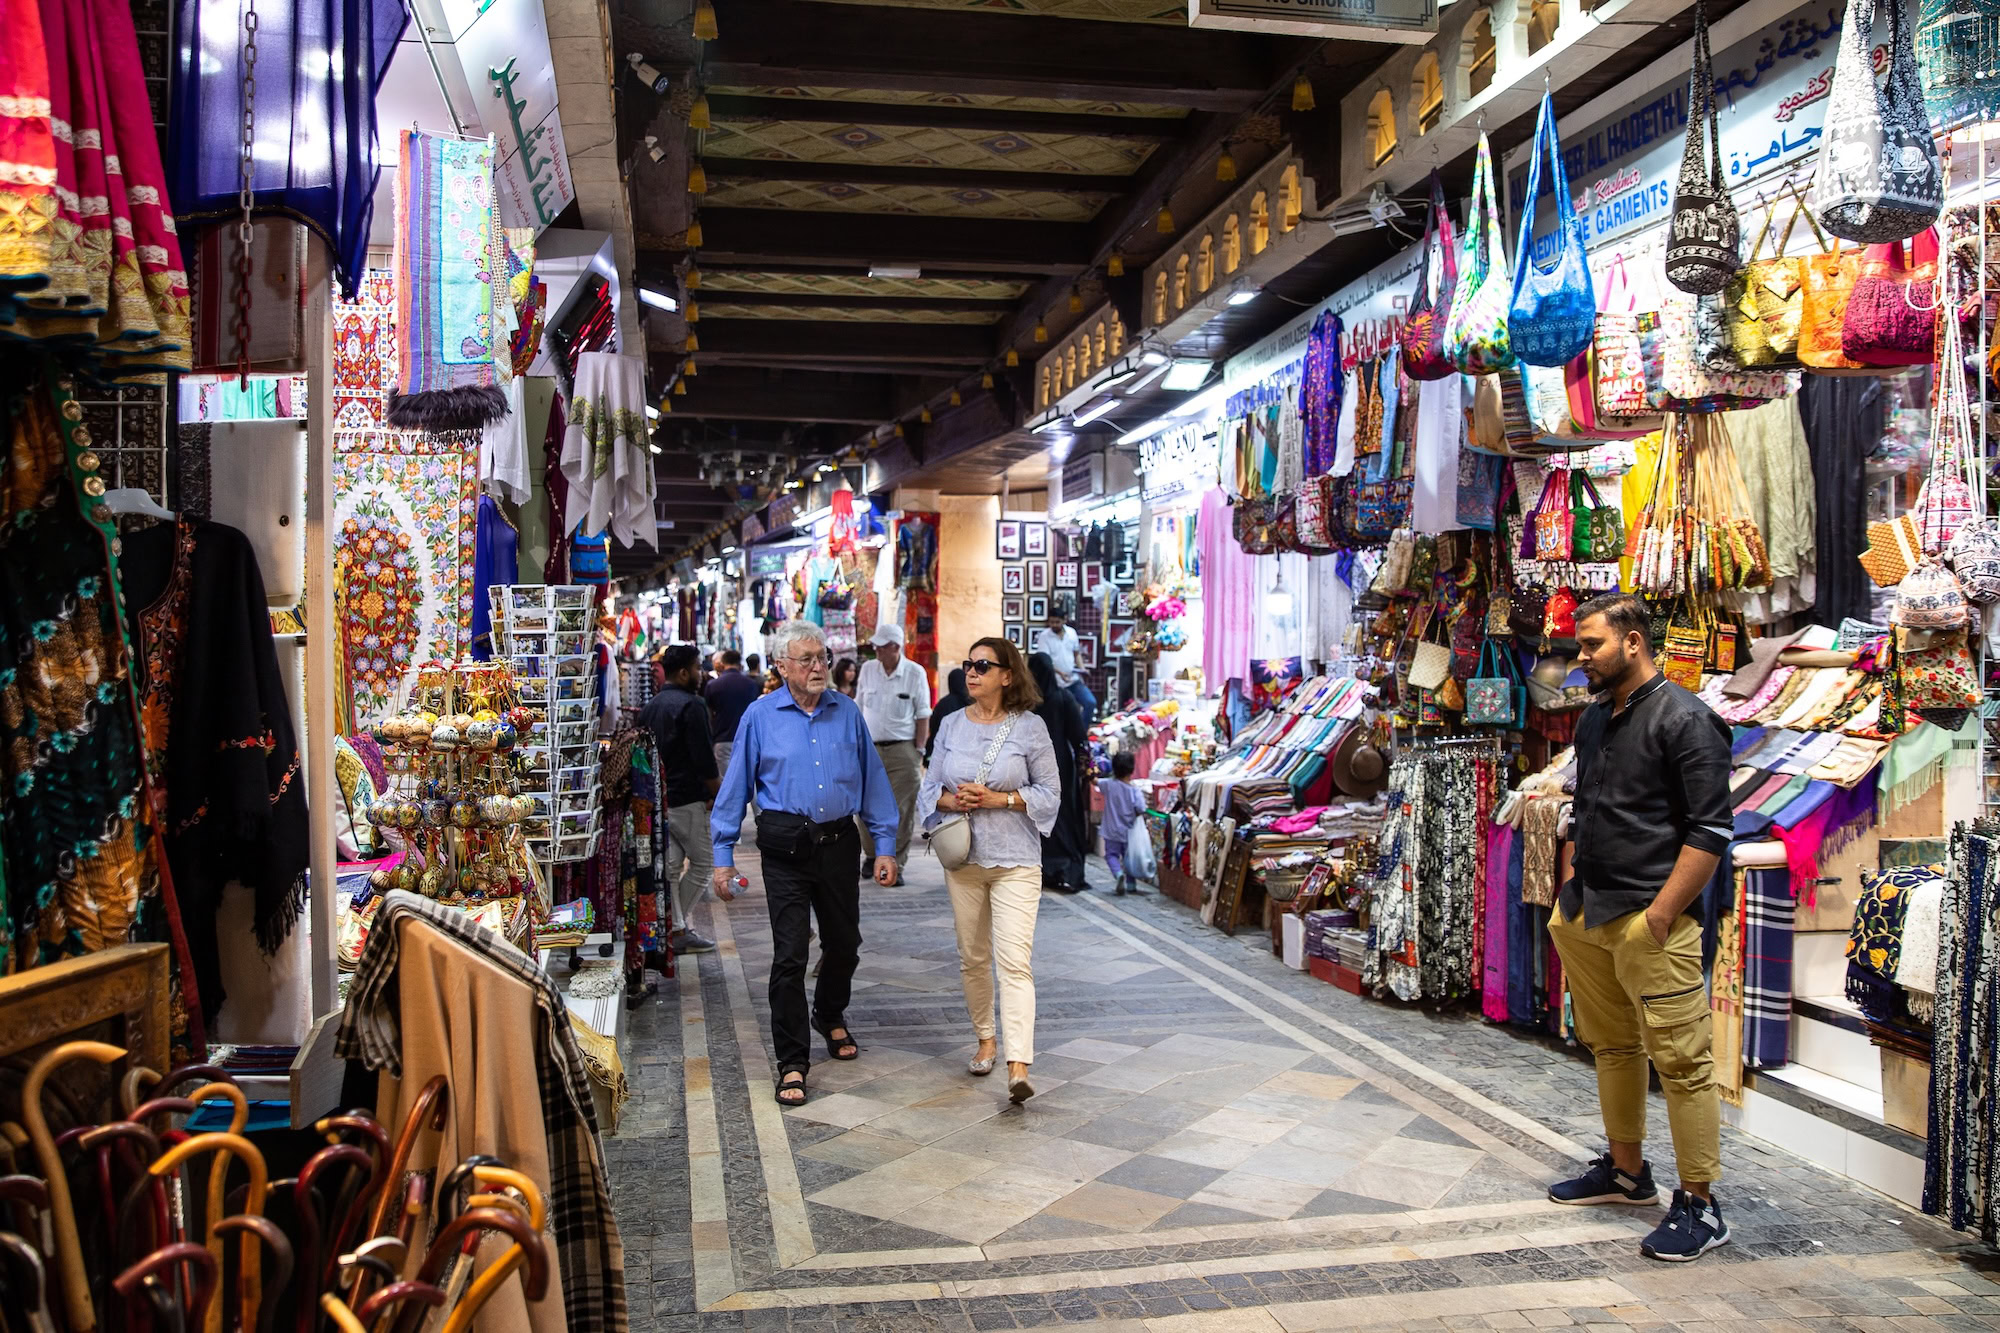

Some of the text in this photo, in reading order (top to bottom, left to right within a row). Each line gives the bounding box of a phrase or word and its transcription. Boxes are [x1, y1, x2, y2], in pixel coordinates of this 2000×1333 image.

[488, 56, 552, 183] كشمير
[1775, 67, 1834, 119] كشمير
[1607, 94, 1676, 161] HADETH
[1731, 126, 1824, 177] جاهزة
[1593, 168, 1642, 205] Kashmir
[1596, 180, 1669, 234] GARMENTS
